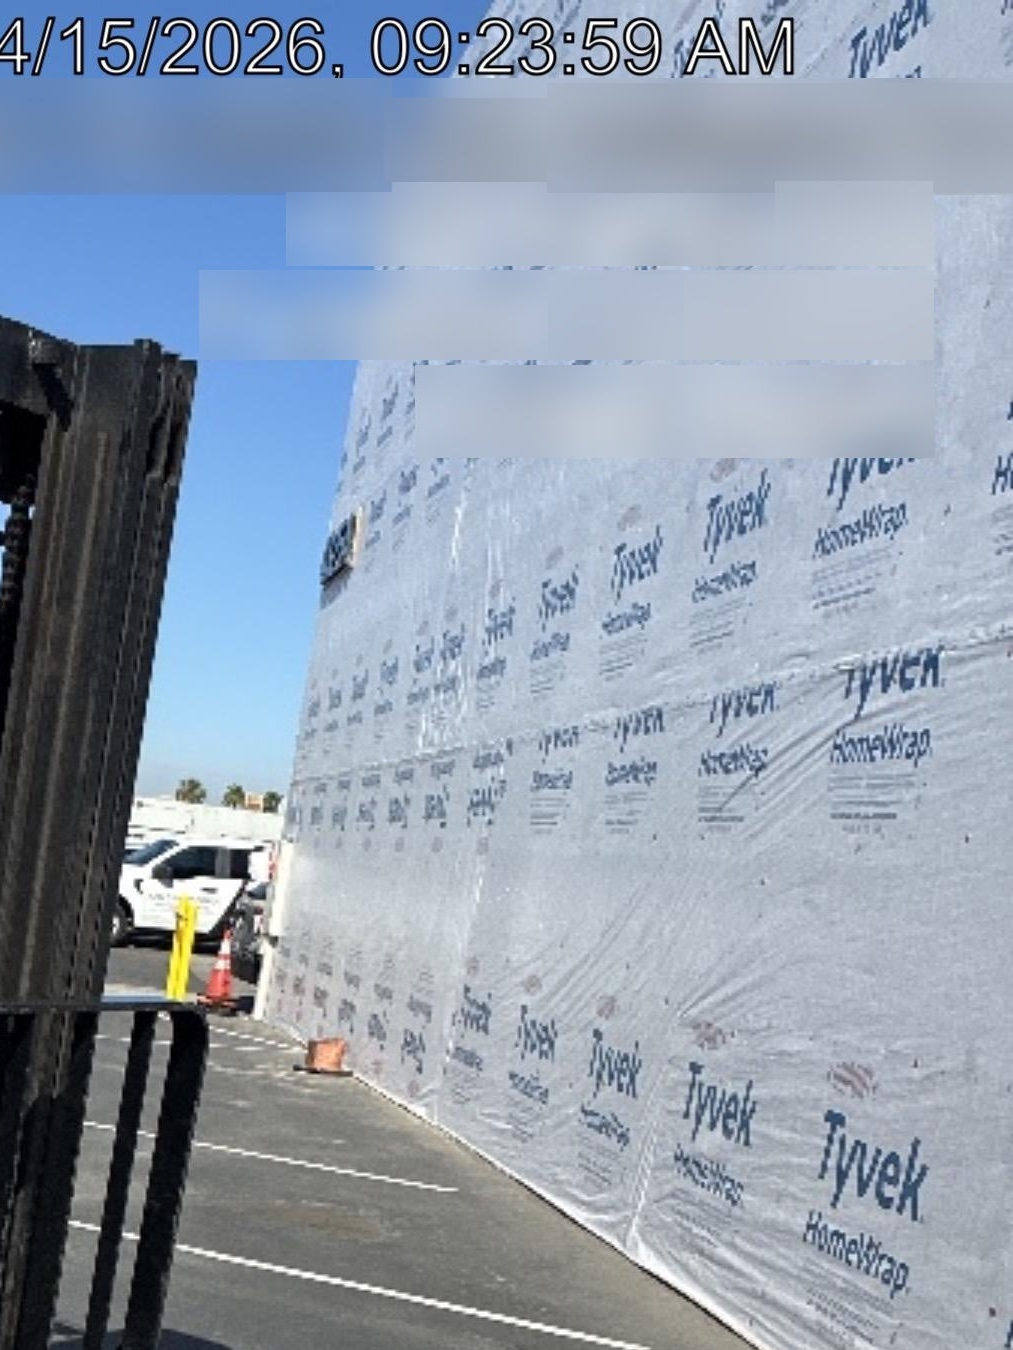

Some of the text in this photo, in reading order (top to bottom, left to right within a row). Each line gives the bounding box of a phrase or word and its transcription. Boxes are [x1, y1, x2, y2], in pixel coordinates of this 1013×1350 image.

[703, 467, 772, 565] Tyvek
[829, 722, 932, 768] HomeWrap
[588, 1027, 643, 1099] Tyvek
[682, 1060, 758, 1148] Tyvek
[817, 1108, 930, 1224] Tyvek
[802, 1209, 912, 1300] HomeWrap
